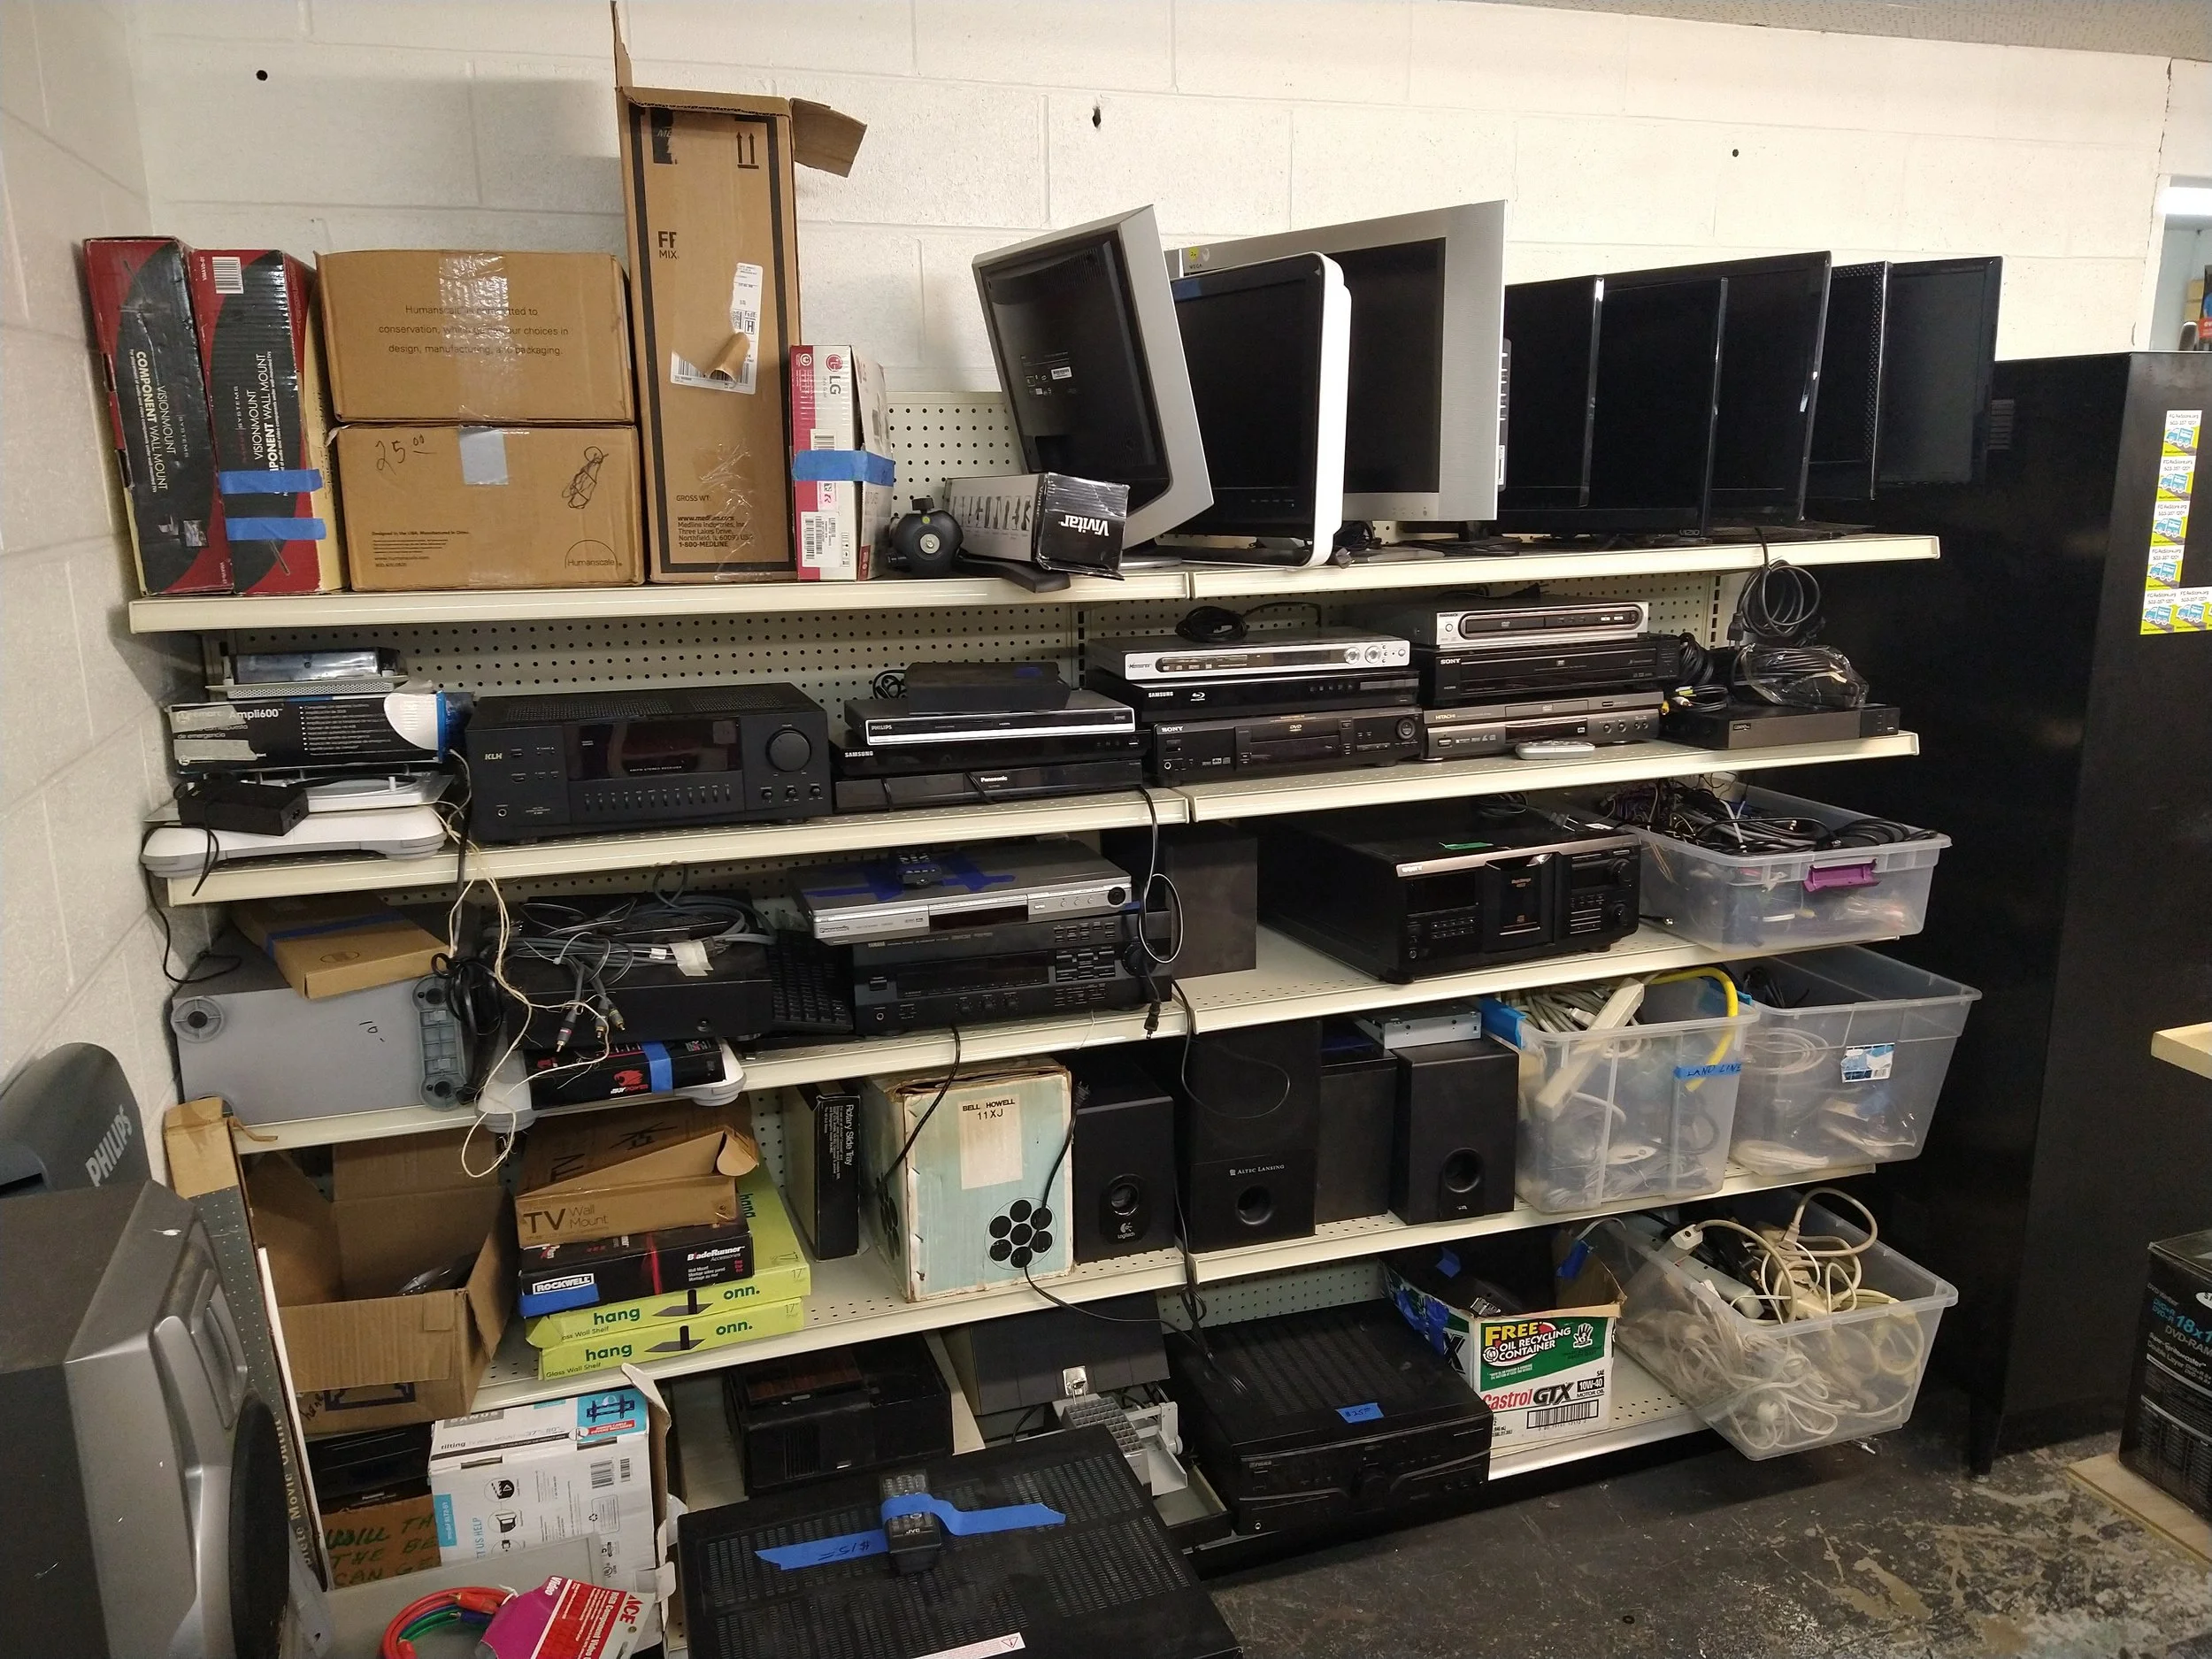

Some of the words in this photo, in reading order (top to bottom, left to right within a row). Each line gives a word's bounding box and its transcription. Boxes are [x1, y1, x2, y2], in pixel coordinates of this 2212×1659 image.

[379, 325, 441, 335] conservation,
[523, 326, 557, 335] choices
[561, 326, 569, 335] in
[388, 344, 422, 355] design,
[515, 346, 564, 357] packaging.
[256, 354, 270, 392] MOUNT
[136, 351, 157, 422] COMPONENT
[830, 376, 841, 395] LG
[261, 394, 272, 420] WALL
[157, 385, 177, 454] VISIONMOUNT
[246, 390, 264, 460] VISIONMOUNT
[150, 426, 161, 452] WALL
[265, 422, 279, 471] PONENT
[154, 453, 168, 490] MOUNT
[1060, 514, 1110, 536] Vivitar
[1687, 1066, 1713, 1077] LAND
[1719, 1063, 1742, 1073] LINE
[986, 1099, 1015, 1108] HOWELL
[844, 1104, 854, 1129] Rotary
[84, 1104, 133, 1187] PHILIPS
[845, 1131, 854, 1149] Slide
[844, 1151, 854, 1166] Tray
[524, 1208, 566, 1233] TV
[569, 1204, 595, 1217] Wall
[570, 1215, 609, 1229] Mount
[687, 1246, 743, 1261] BladeRunner
[710, 1253, 741, 1262] Accessories
[536, 1277, 591, 1292] ROCKWELL
[723, 1285, 760, 1300] onn.
[593, 1307, 641, 1325] hang
[592, 1326, 609, 1335] Shelf
[716, 1321, 753, 1336] onn.
[1485, 1322, 1539, 1347] FREE
[1499, 1342, 1517, 1351] OIL
[1519, 1327, 1571, 1348] RECYCLING
[585, 1343, 633, 1361] hang
[1499, 1340, 1555, 1360] CONTAINER
[546, 1369, 565, 1378] Glass
[584, 1362, 601, 1371] Shelf
[2167, 1354, 2185, 1368] Layer
[1579, 1379, 1603, 1390] 10W-40
[1483, 1389, 1533, 1410] Castrol
[1533, 1382, 1575, 1406] GTX
[441, 1441, 466, 1449] tilting
[285, 1473, 301, 1521] Movie
[472, 1518, 483, 1536] HELP
[474, 1538, 484, 1548] US
[544, 1576, 562, 1596] Video
[620, 1594, 644, 1624] ACE
[585, 1639, 599, 1656] Video
